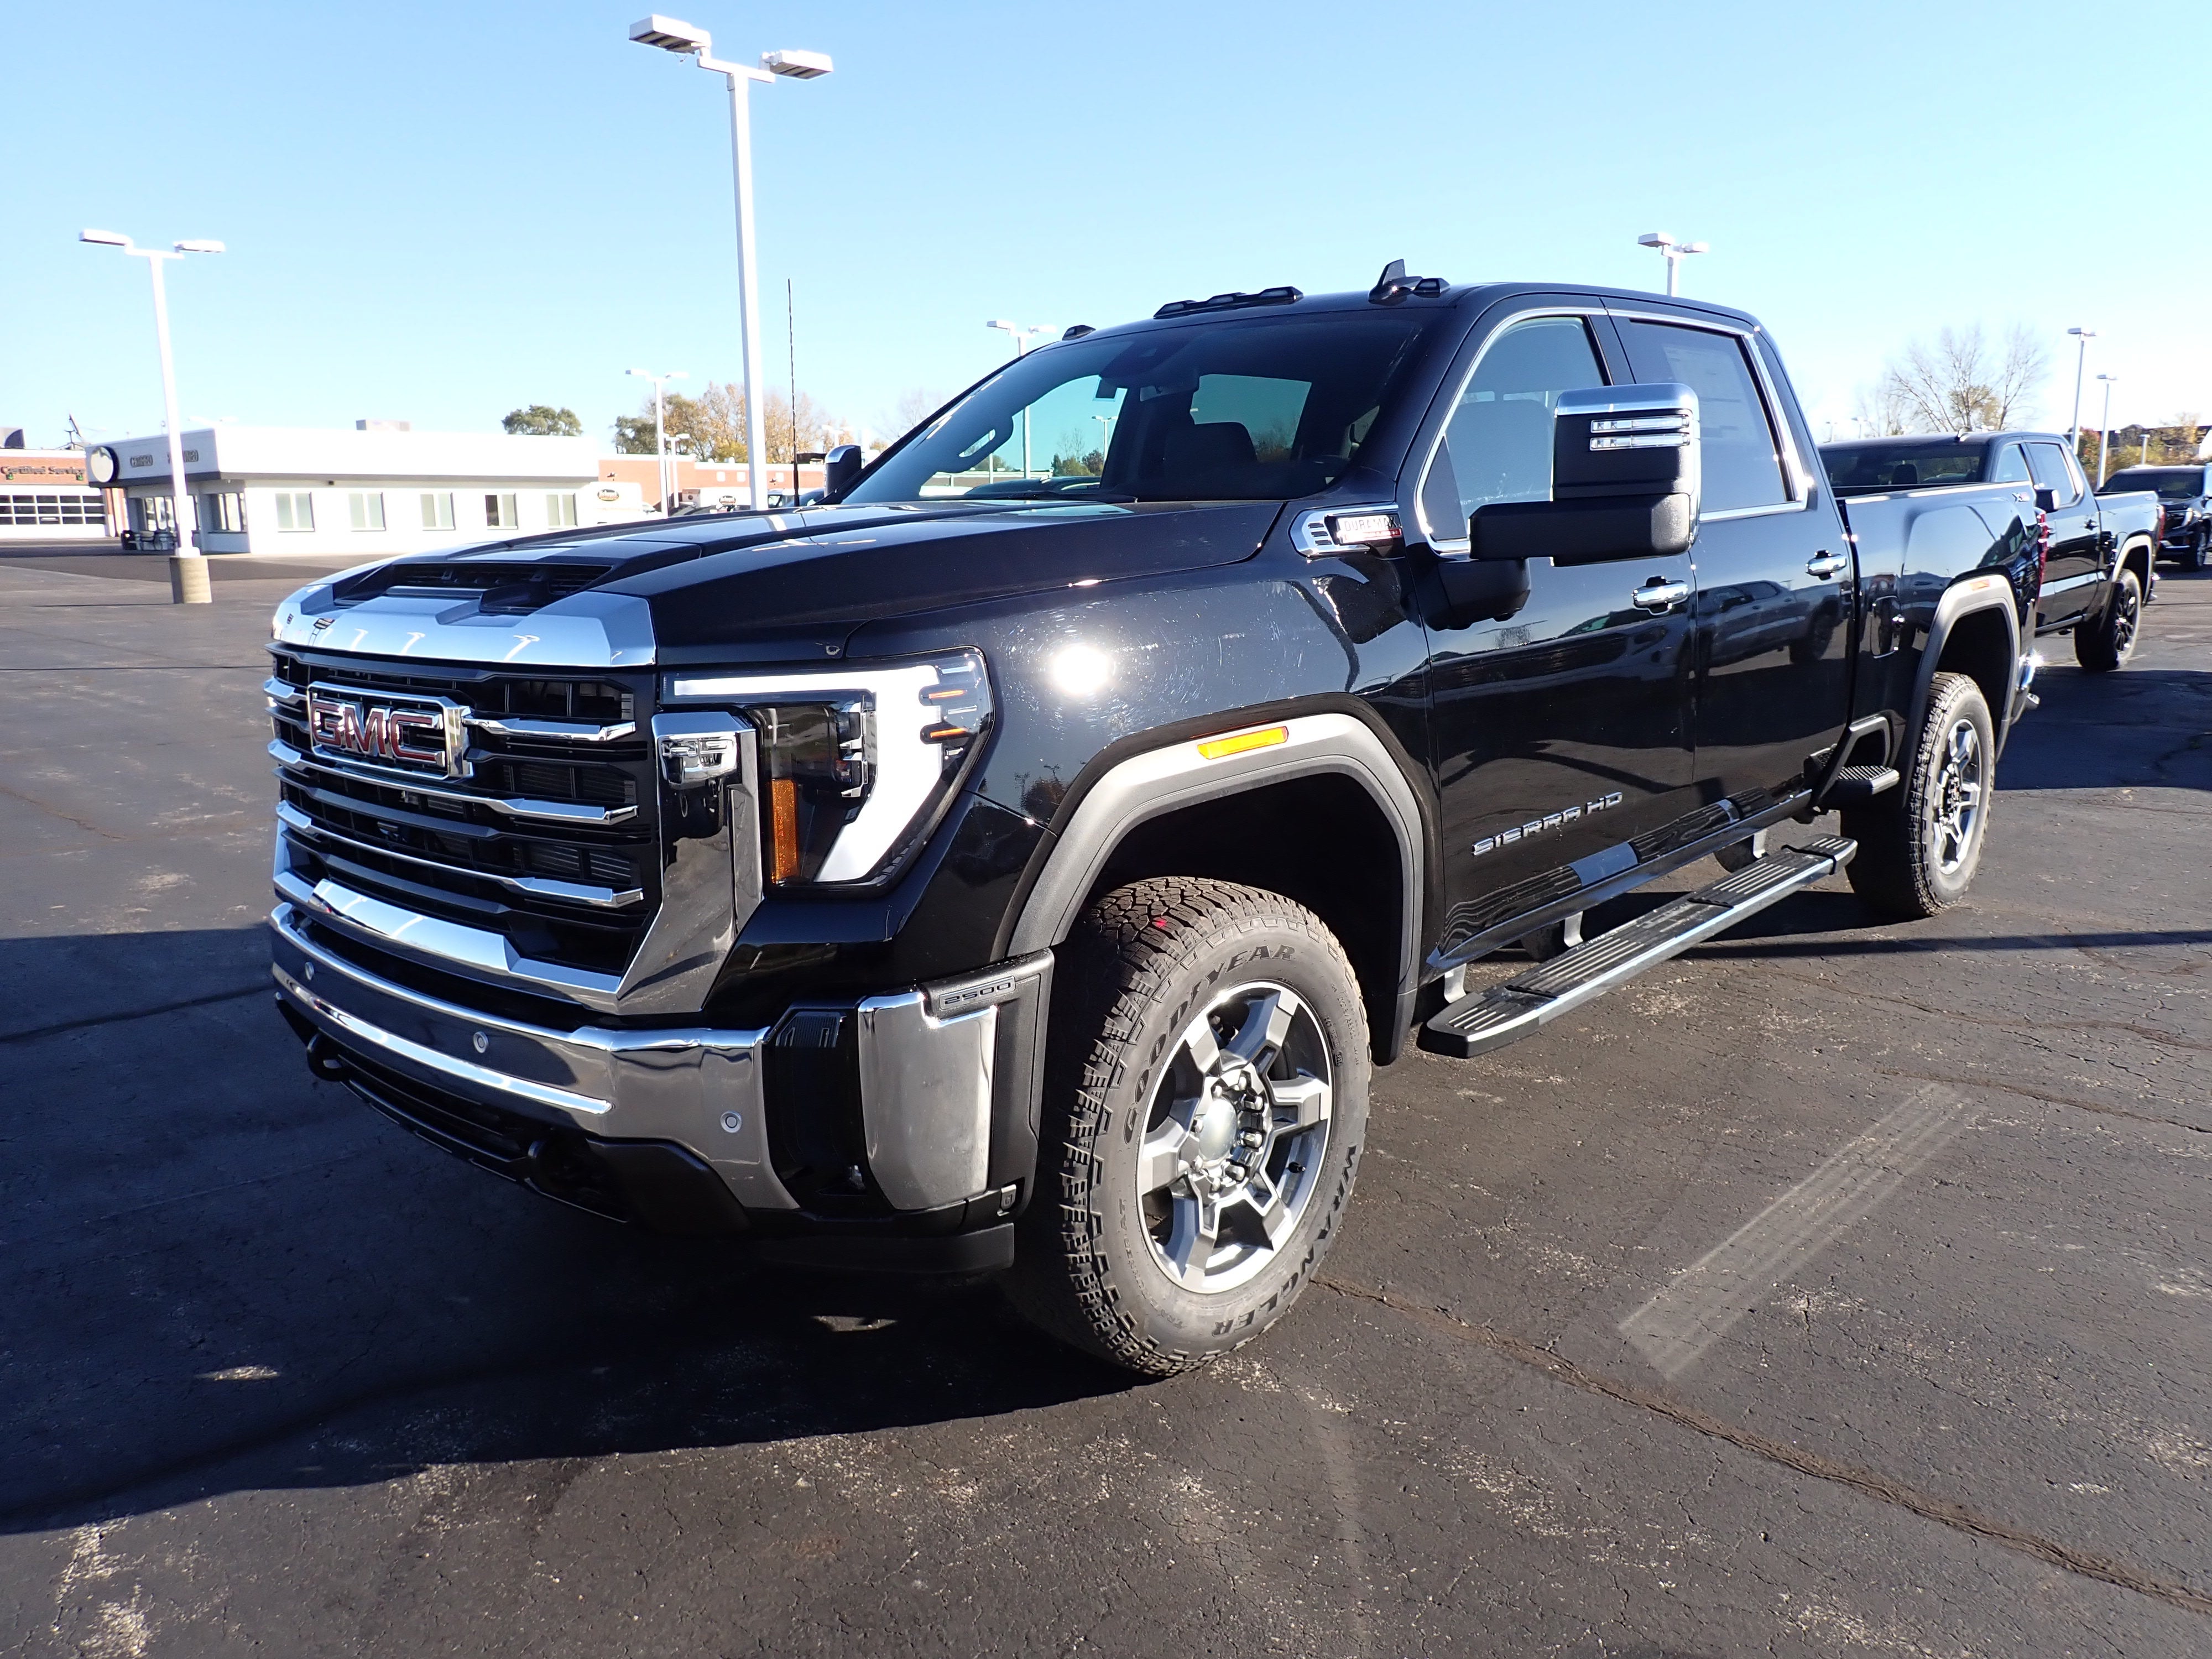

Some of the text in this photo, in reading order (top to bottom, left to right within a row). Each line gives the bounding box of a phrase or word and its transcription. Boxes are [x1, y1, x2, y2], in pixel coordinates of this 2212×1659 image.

[311, 699, 446, 768] GMC
[1472, 791, 1623, 857] SIERRA HD
[944, 982, 1011, 1005] 2500
[1124, 944, 1295, 1145] GOODYEAR
[1212, 1145, 1357, 1337] WRANGLER
